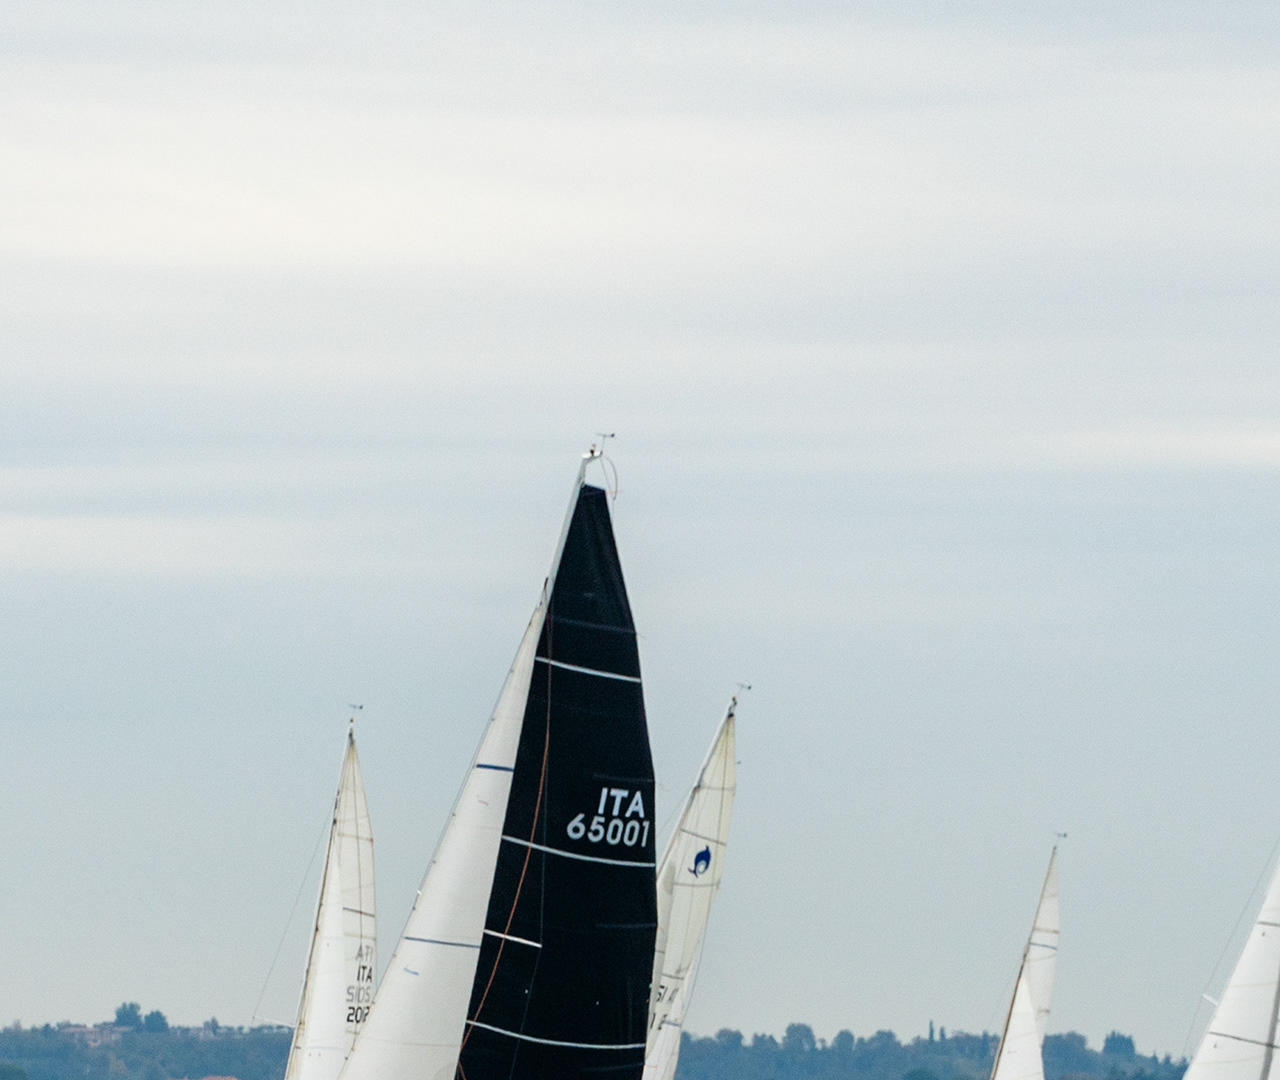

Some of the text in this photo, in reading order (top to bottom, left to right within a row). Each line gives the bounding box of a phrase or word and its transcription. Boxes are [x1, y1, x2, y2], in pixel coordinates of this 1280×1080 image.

[598, 787, 645, 818] ITA
[566, 813, 650, 848] 65001
[356, 965, 373, 982] ITA
